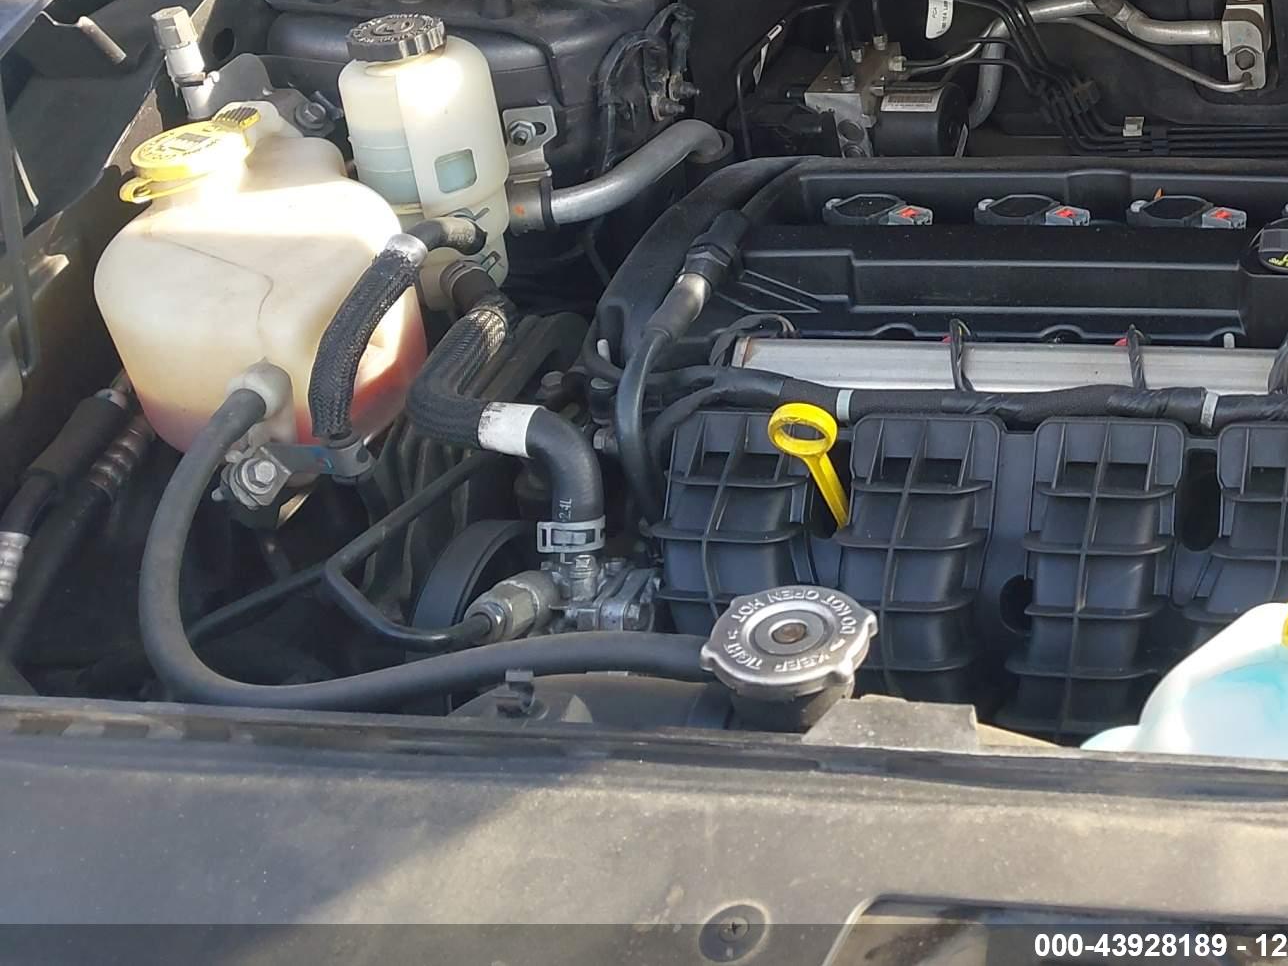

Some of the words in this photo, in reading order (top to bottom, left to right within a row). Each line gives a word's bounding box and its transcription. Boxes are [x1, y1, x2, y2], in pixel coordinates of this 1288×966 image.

[768, 590, 820, 603] OPEN
[821, 595, 852, 617] NOT
[731, 598, 766, 622] HOT
[840, 616, 858, 634] DO
[723, 643, 763, 670] TIGHT
[774, 652, 831, 672] KEEP
